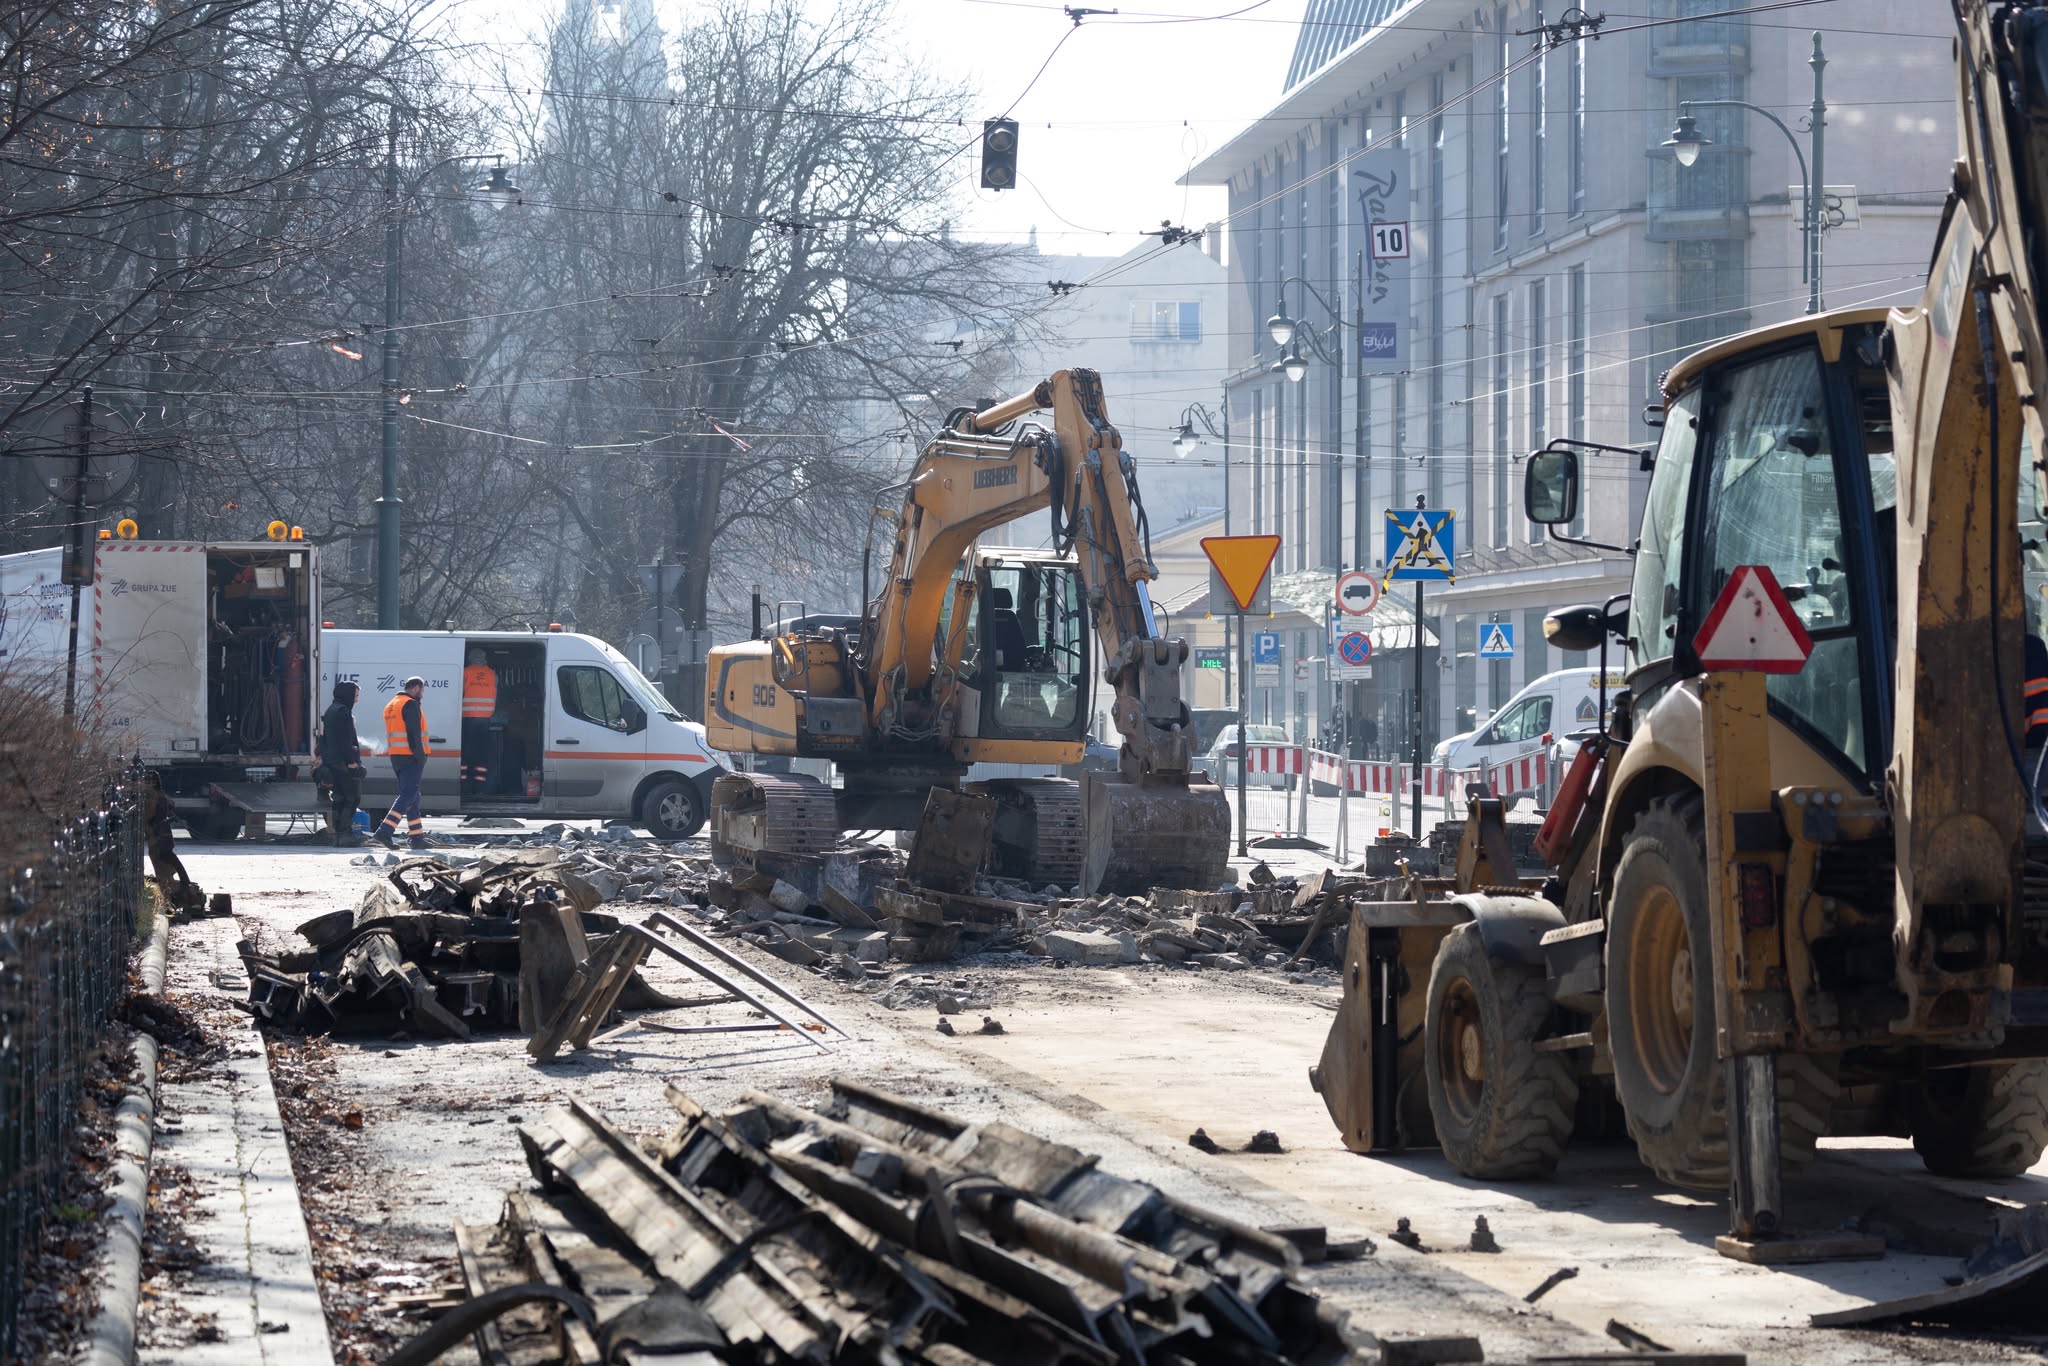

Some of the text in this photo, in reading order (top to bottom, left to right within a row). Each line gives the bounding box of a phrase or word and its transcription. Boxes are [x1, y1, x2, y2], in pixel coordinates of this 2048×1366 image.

[1376, 228, 1403, 253] 10
[973, 464, 1018, 490] LIEBHERR
[131, 584, 177, 592] GRUPA ZUE
[1202, 659, 1222, 669] FREE
[431, 680, 449, 688] ZUE
